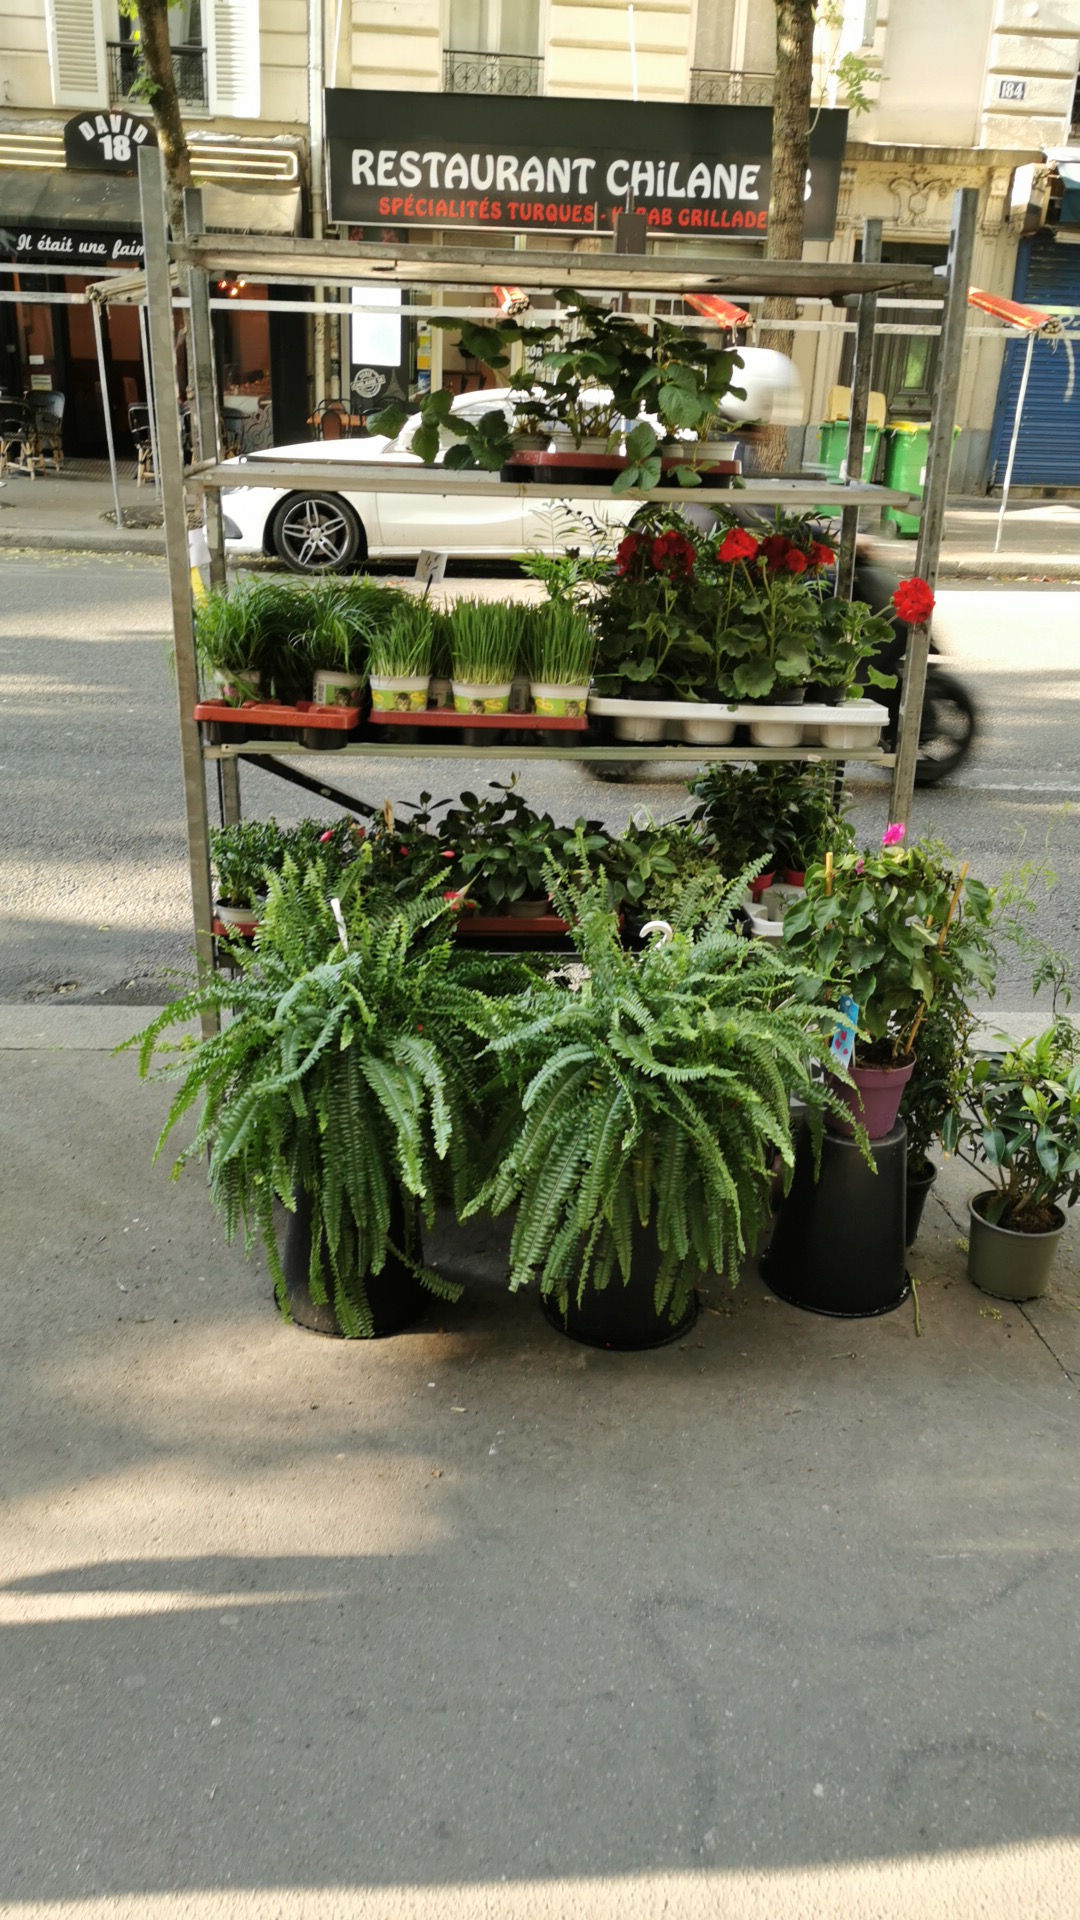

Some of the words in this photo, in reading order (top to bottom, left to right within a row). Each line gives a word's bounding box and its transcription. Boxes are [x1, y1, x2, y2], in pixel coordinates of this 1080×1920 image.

[1001, 81, 1024, 98] 184
[78, 114, 148, 144] DAVID
[99, 134, 131, 162] 18
[352, 149, 596, 194] RESTAURANT
[378, 193, 502, 220] SPÉCIALITÉS
[507, 201, 595, 223] TURQUES
[611, 206, 672, 226] KAB
[16, 233, 32, 251] Il
[37, 234, 73, 253] était
[79, 242, 107, 254] une
